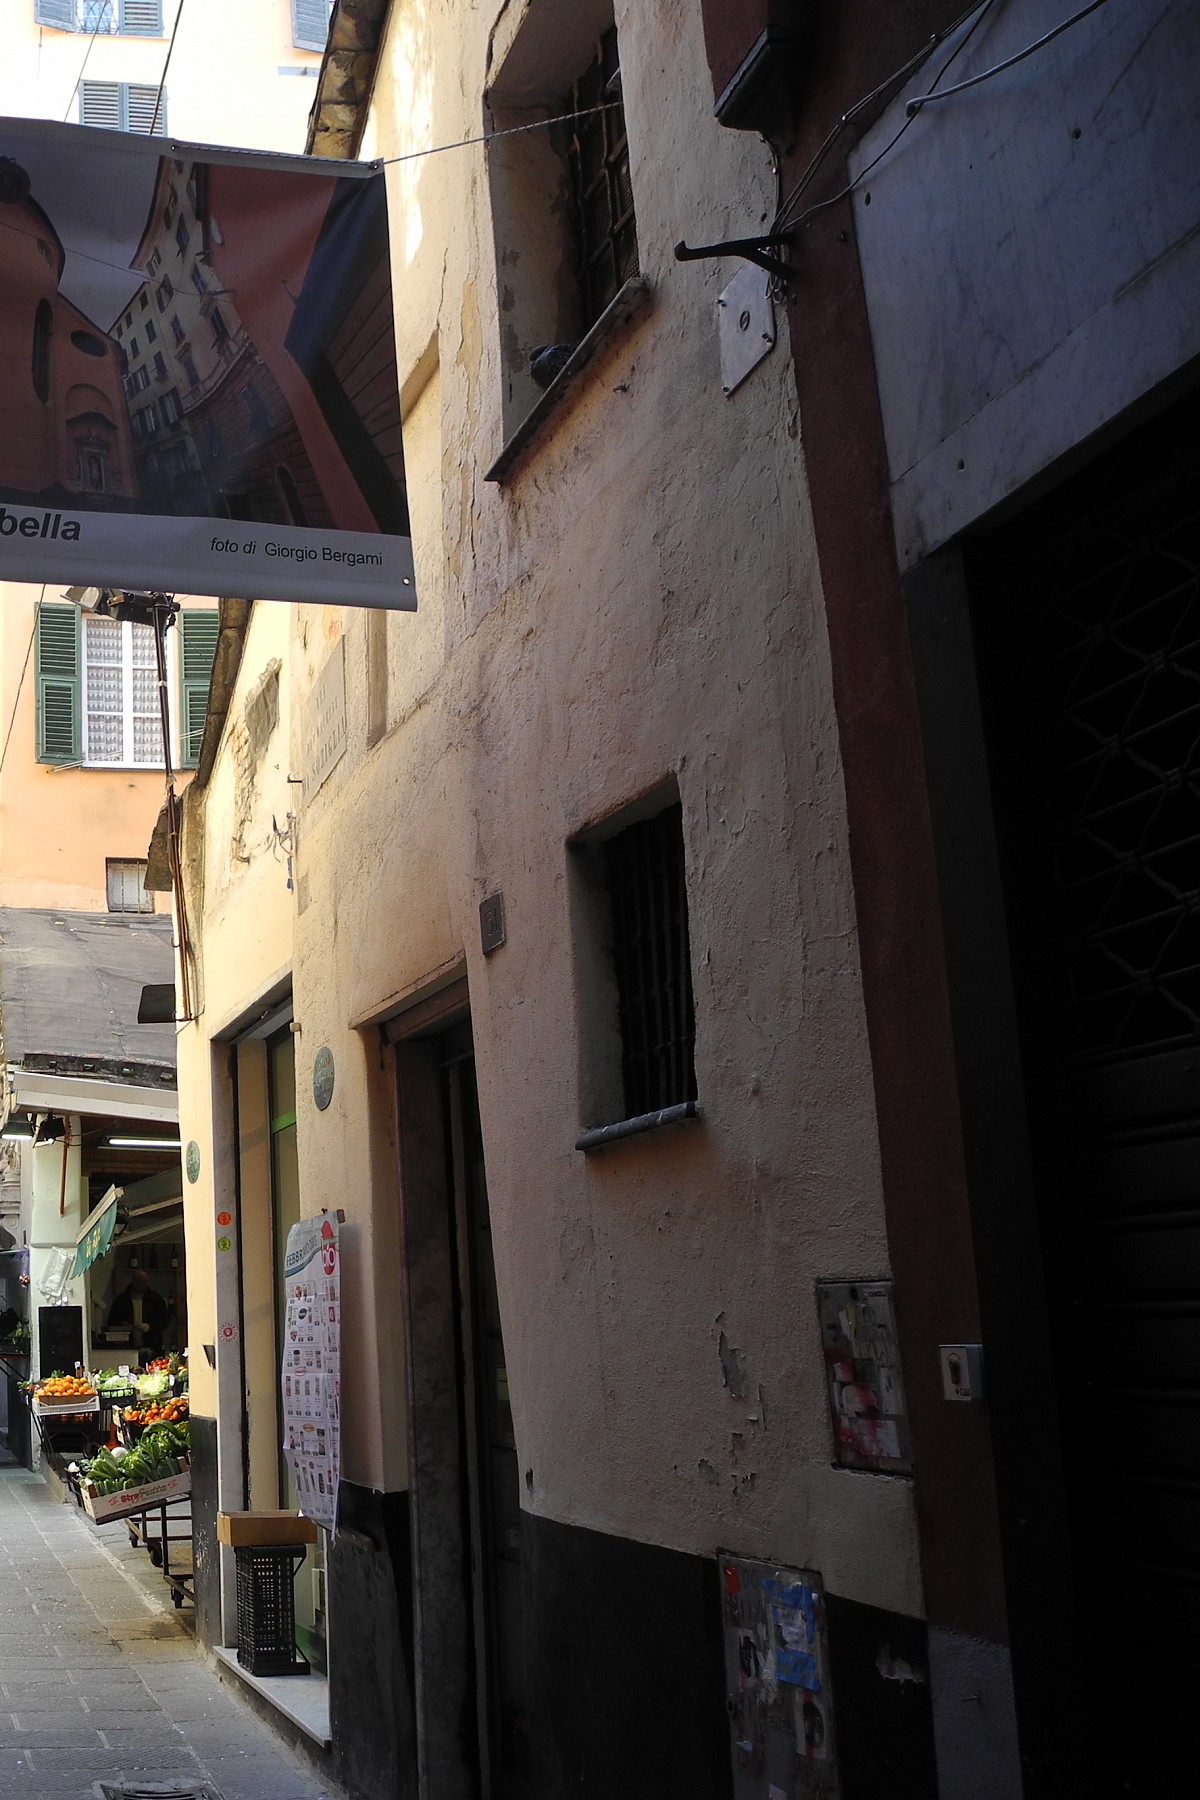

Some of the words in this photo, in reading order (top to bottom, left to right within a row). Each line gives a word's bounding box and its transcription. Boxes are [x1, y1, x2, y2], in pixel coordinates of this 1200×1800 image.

[210, 537, 239, 553] foto
[243, 541, 257, 555] di
[264, 542, 318, 562] Giorgio
[322, 547, 383, 566] Bergami
